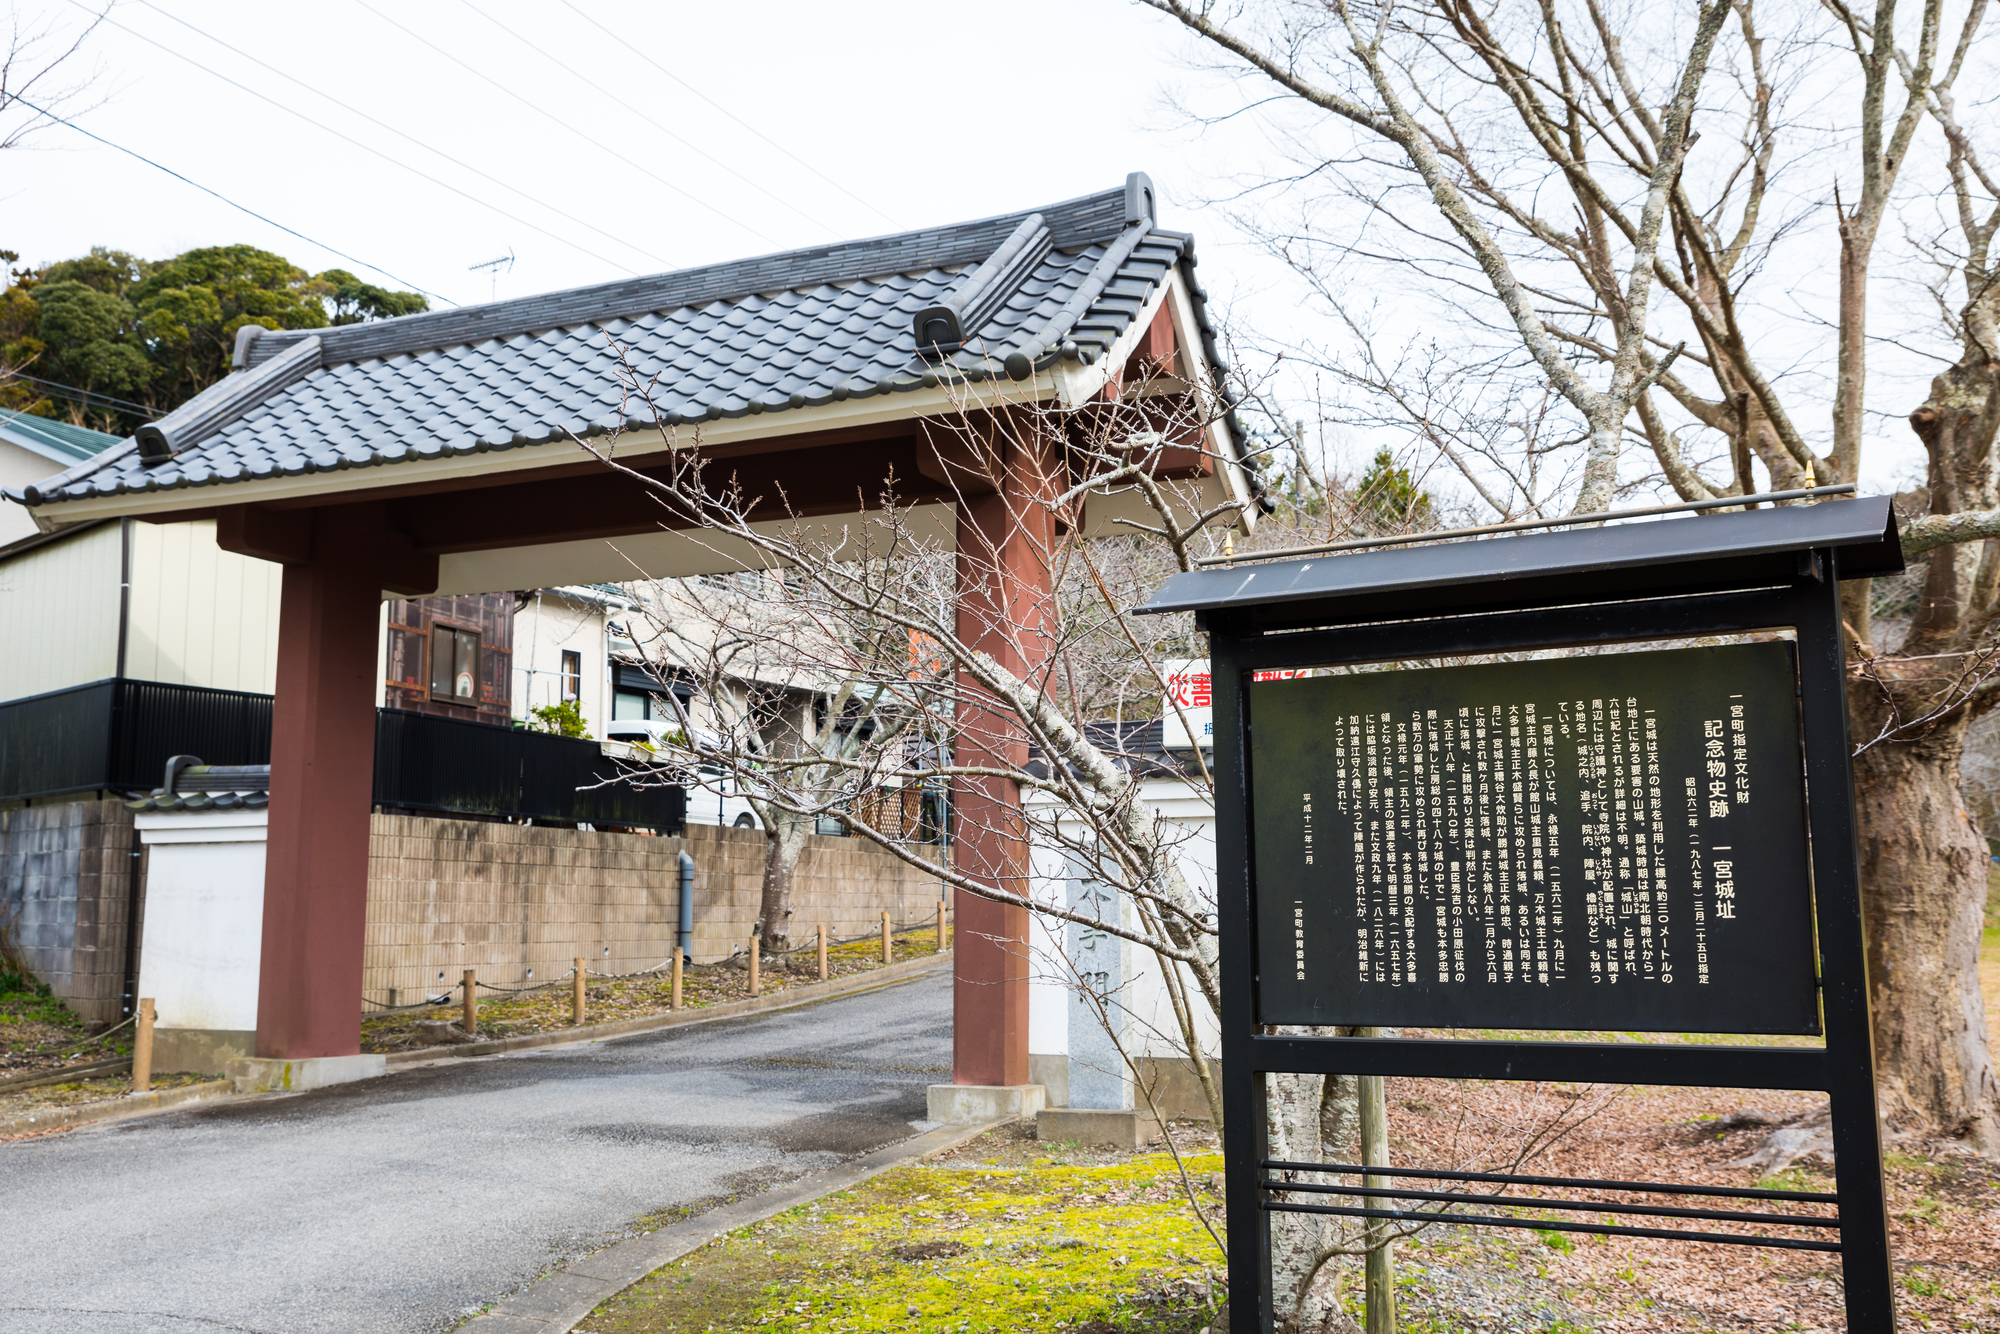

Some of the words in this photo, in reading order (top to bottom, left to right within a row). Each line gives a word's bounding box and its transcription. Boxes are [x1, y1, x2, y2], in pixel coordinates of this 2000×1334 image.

[1335, 715, 1348, 815] よって取り壊された。
[1558, 701, 1571, 739] ている。
[1704, 719, 1730, 819] 記念物史跡
[1730, 694, 1750, 804] 一宮町指定文化財
[1303, 793, 1314, 865] 平成十二年二月
[1412, 710, 1430, 900] ら数万の軍勢に攻められ再び落城した。
[1459, 707, 1480, 922] 頃に落城、と諸説あり史実は判然としない。
[1711, 845, 1737, 920] 一宮城址
[1294, 900, 1306, 981] 一宮町教育委員会
